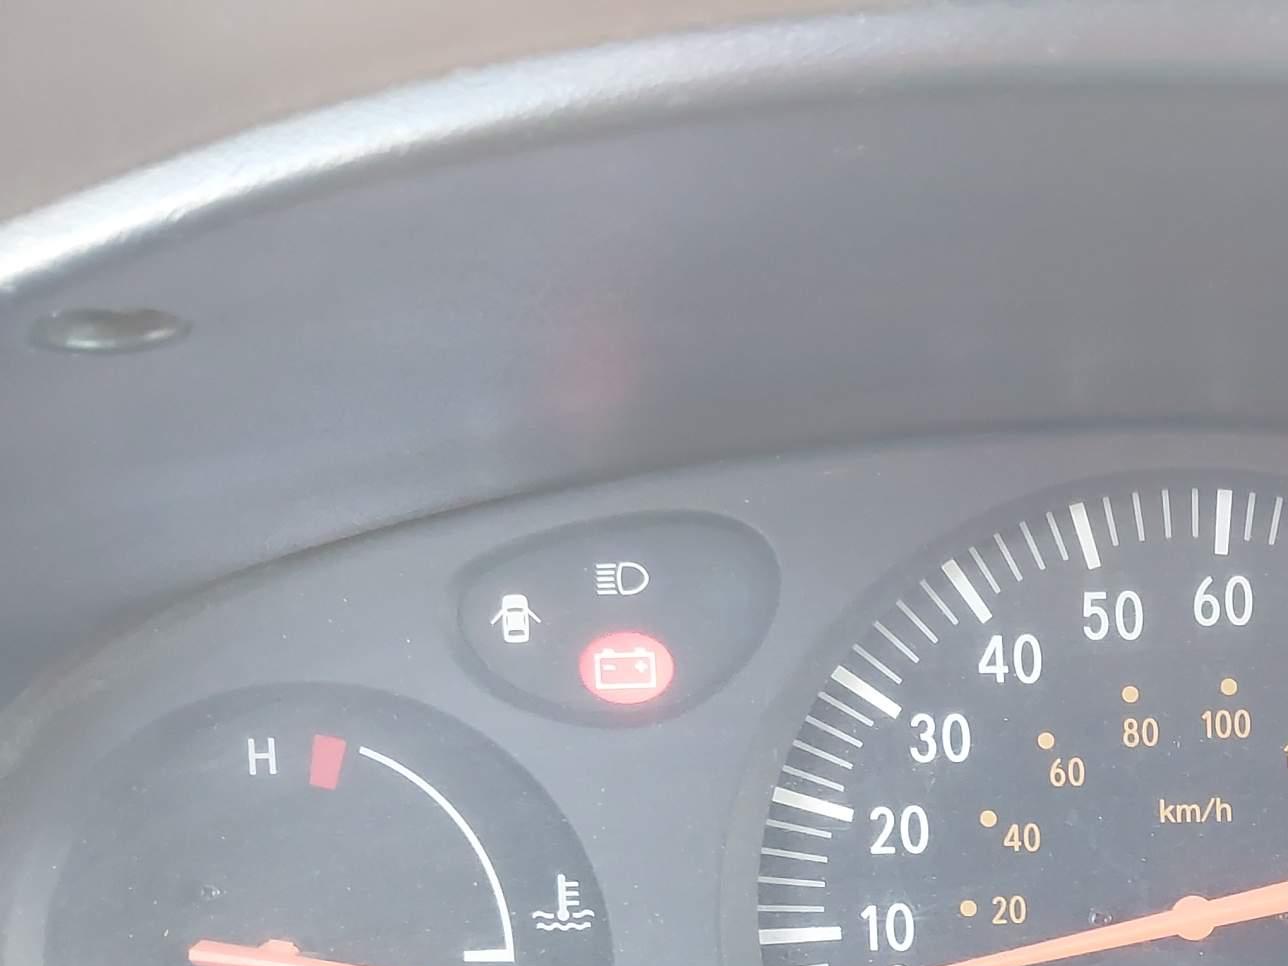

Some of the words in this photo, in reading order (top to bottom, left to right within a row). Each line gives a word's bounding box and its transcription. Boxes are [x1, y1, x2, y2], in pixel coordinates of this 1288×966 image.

[1084, 591, 1143, 640] 50
[1194, 576, 1252, 626] 60
[979, 634, 1041, 683] 40
[910, 713, 970, 763] 30
[1123, 718, 1158, 747] 80
[1202, 710, 1250, 738] 100
[248, 738, 277, 775] H
[1050, 758, 1084, 786] 60
[1160, 798, 1231, 823] km/h
[870, 805, 928, 854] 20
[1004, 823, 1040, 851] 40
[861, 903, 914, 951] 10
[992, 896, 1026, 924] 20
